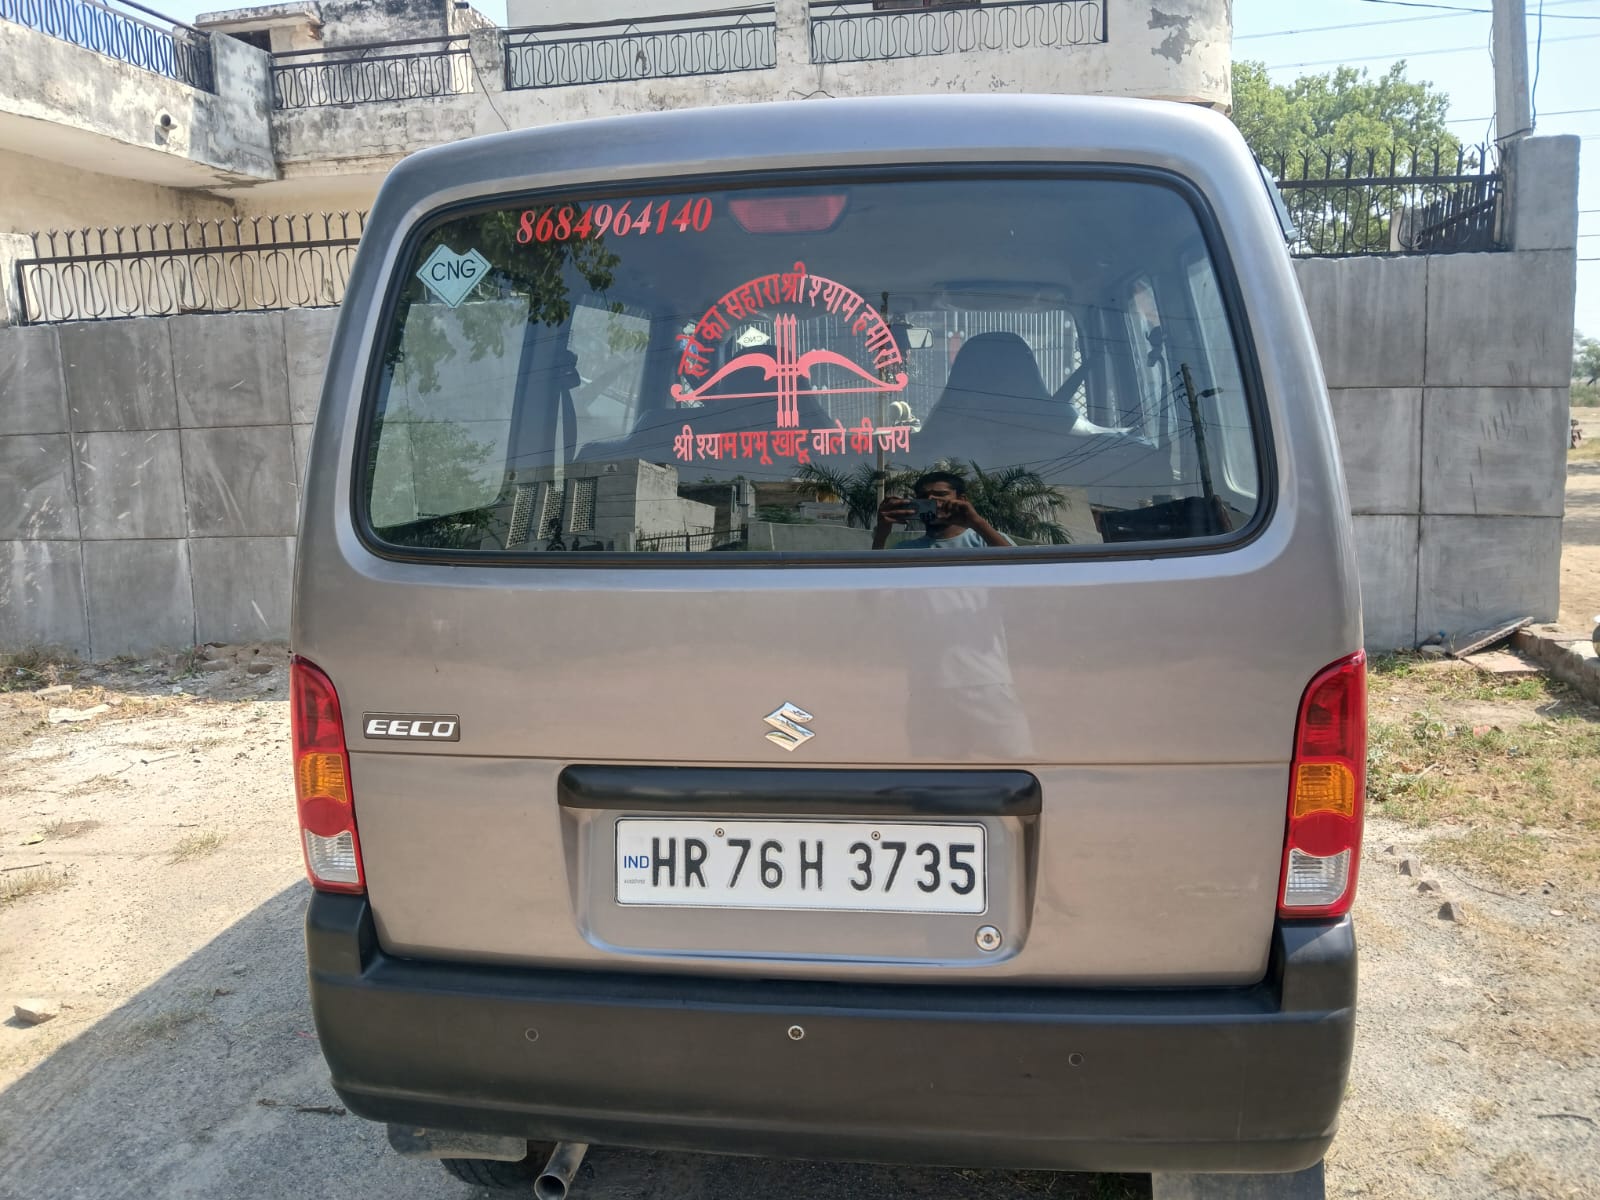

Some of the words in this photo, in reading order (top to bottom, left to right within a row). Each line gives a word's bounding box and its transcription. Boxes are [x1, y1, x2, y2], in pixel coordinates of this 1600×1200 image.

[516, 197, 713, 244] 8684964140
[431, 259, 476, 281] CNG
[781, 260, 809, 304] श्री
[717, 273, 781, 320] सहारा
[808, 274, 865, 323] श्याम
[694, 305, 731, 341] का
[851, 303, 903, 370] हमारा
[676, 334, 715, 377] हारे
[673, 424, 694, 462] श्री
[695, 432, 738, 460] श्याम
[770, 429, 811, 465] खाटू
[811, 418, 847, 456] वाले
[848, 417, 874, 455] की
[875, 425, 911, 453] जय
[366, 719, 457, 737] EECO
[624, 856, 649, 869] IND
[652, 837, 707, 888] HR
[727, 838, 783, 889] 76
[800, 840, 824, 891] H
[849, 841, 976, 895] 3735
